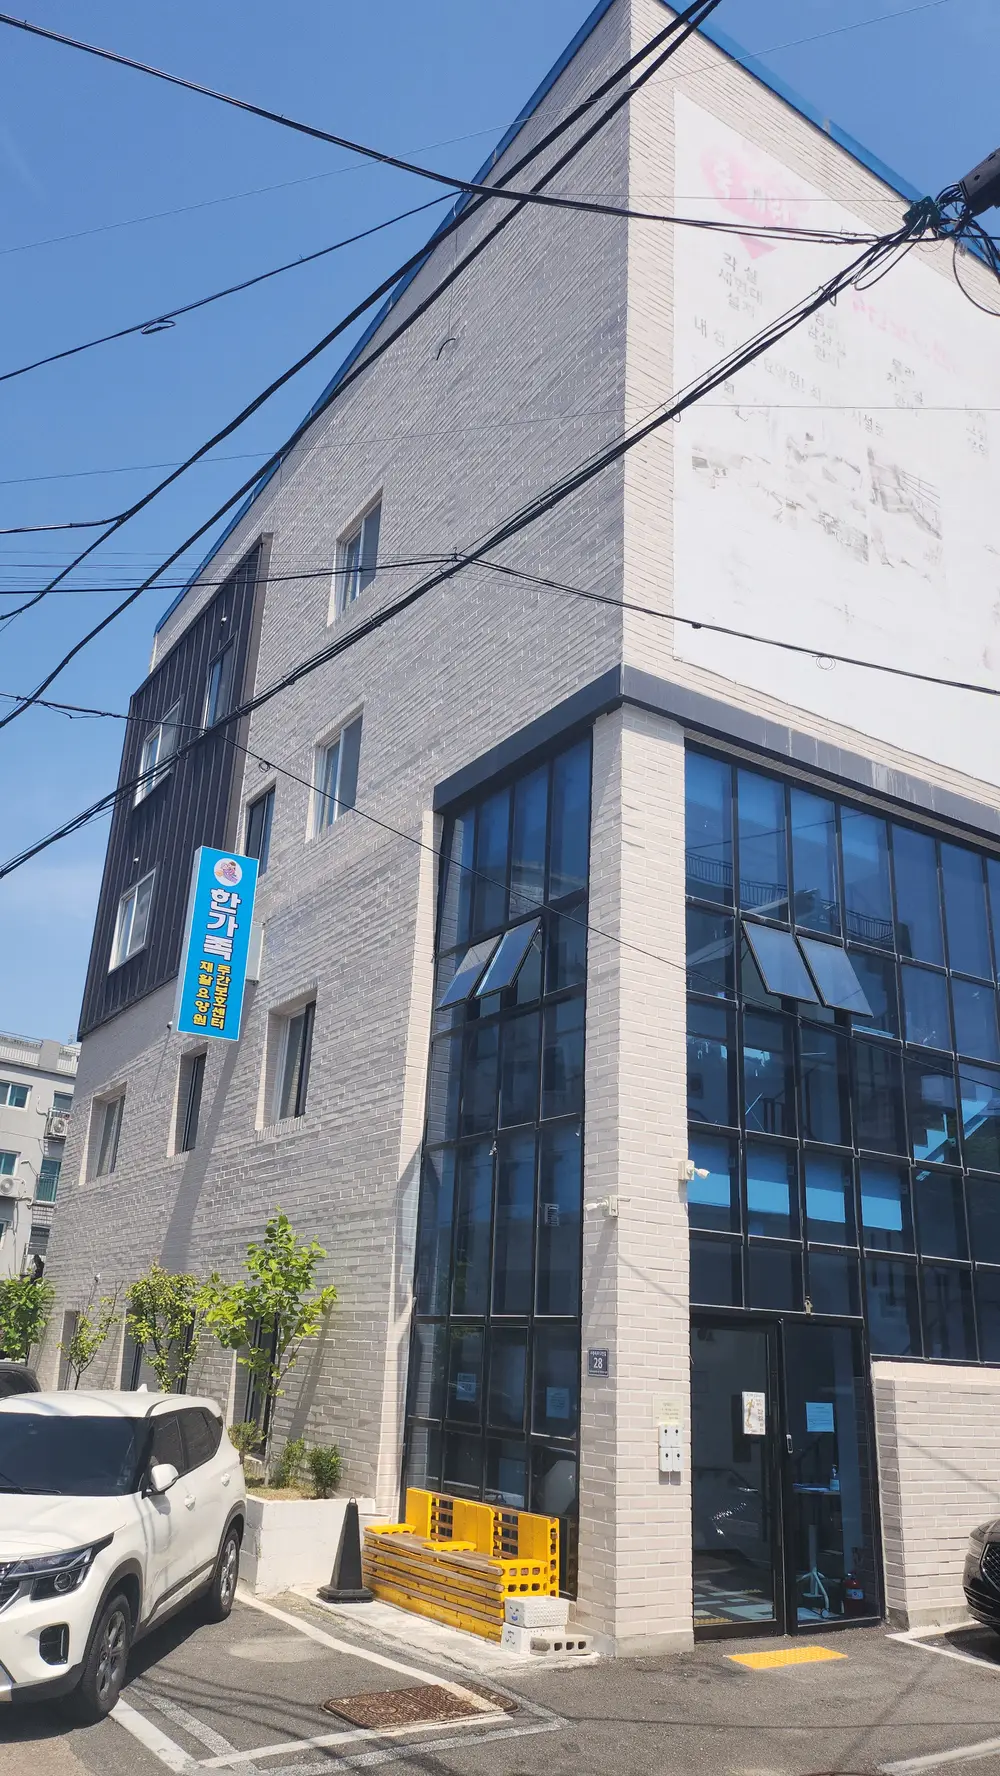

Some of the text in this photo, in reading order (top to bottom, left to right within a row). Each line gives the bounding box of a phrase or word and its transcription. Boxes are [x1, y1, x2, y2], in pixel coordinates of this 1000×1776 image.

[203, 888, 241, 962] 한가족
[192, 960, 214, 1026] 재활요양원
[211, 964, 231, 1030] 주간보호센터
[593, 1357, 603, 1369] 28
